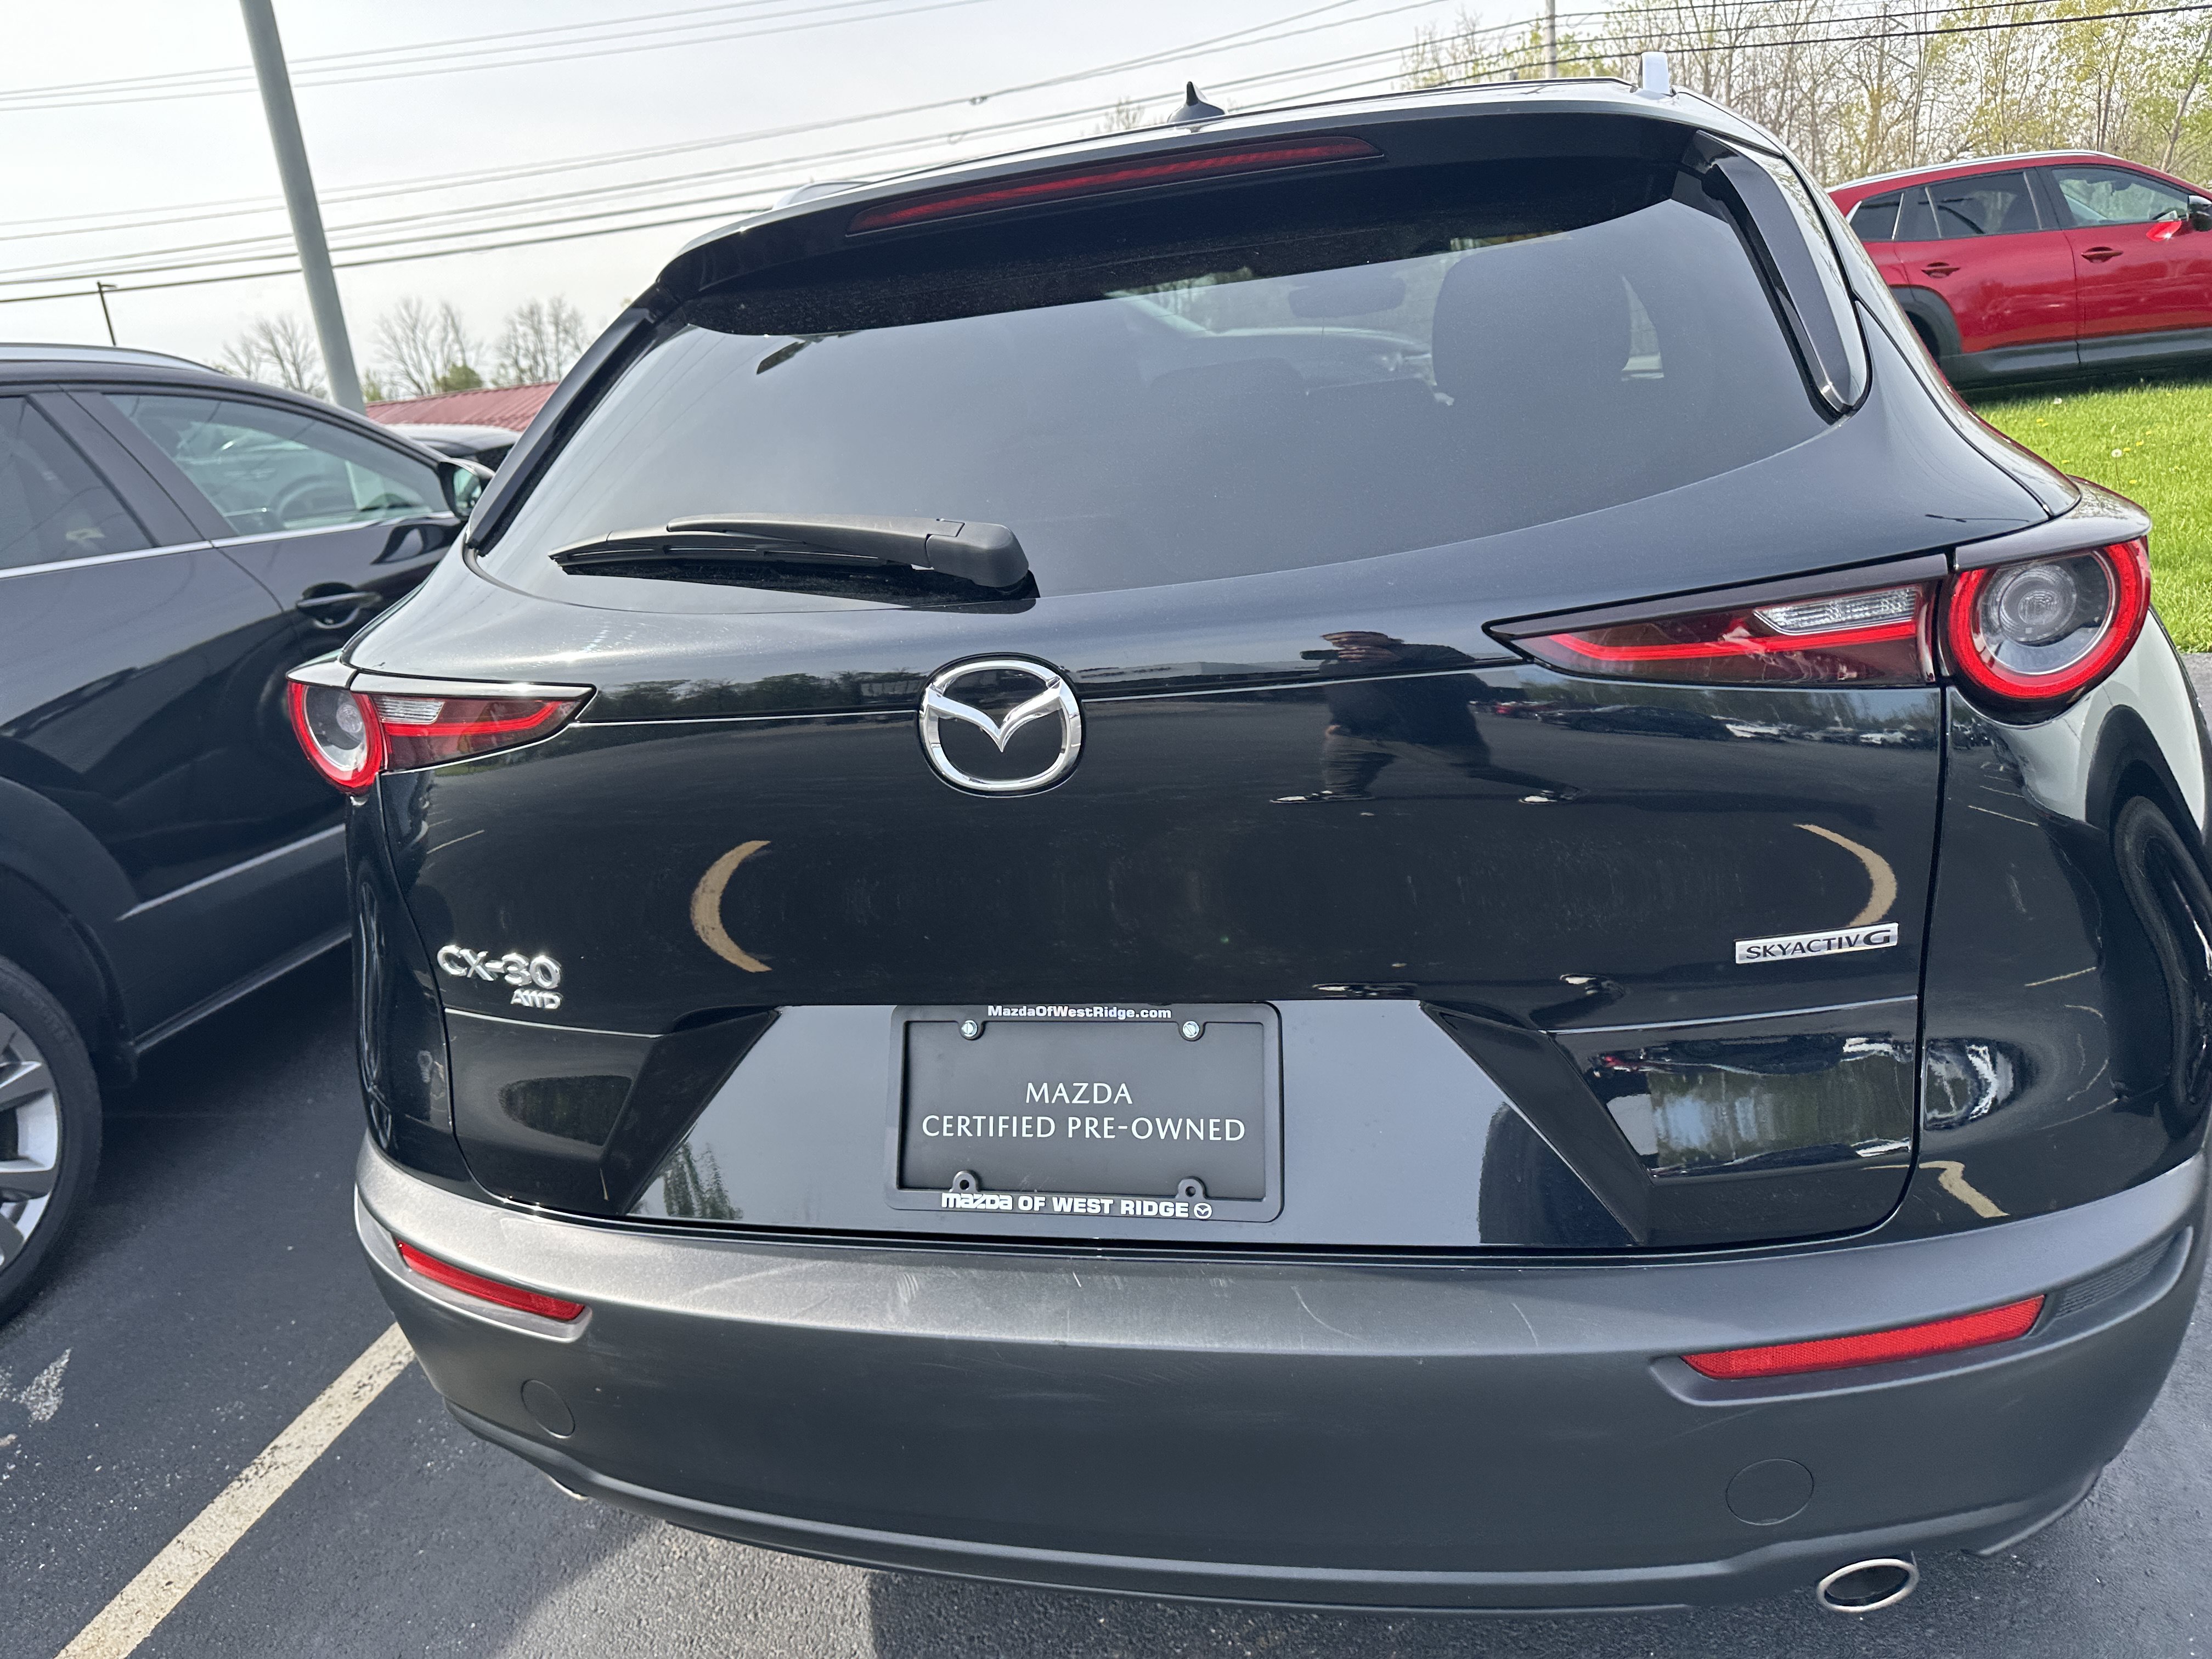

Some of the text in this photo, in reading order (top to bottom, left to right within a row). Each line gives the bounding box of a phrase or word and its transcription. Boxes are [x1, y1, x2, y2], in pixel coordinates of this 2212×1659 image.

[437, 945, 562, 989] CX-30
[510, 989, 563, 1009] AWD
[988, 1005, 1172, 1019] MazdaOfWestRidge.com
[1025, 1082, 1133, 1104] MAZDA
[922, 1115, 1246, 1141] CERTIFIED PRE-OWNED
[1018, 1196, 1045, 1212] OF
[1052, 1197, 1114, 1215] WEST
[1120, 1199, 1189, 1217] RIDGE
